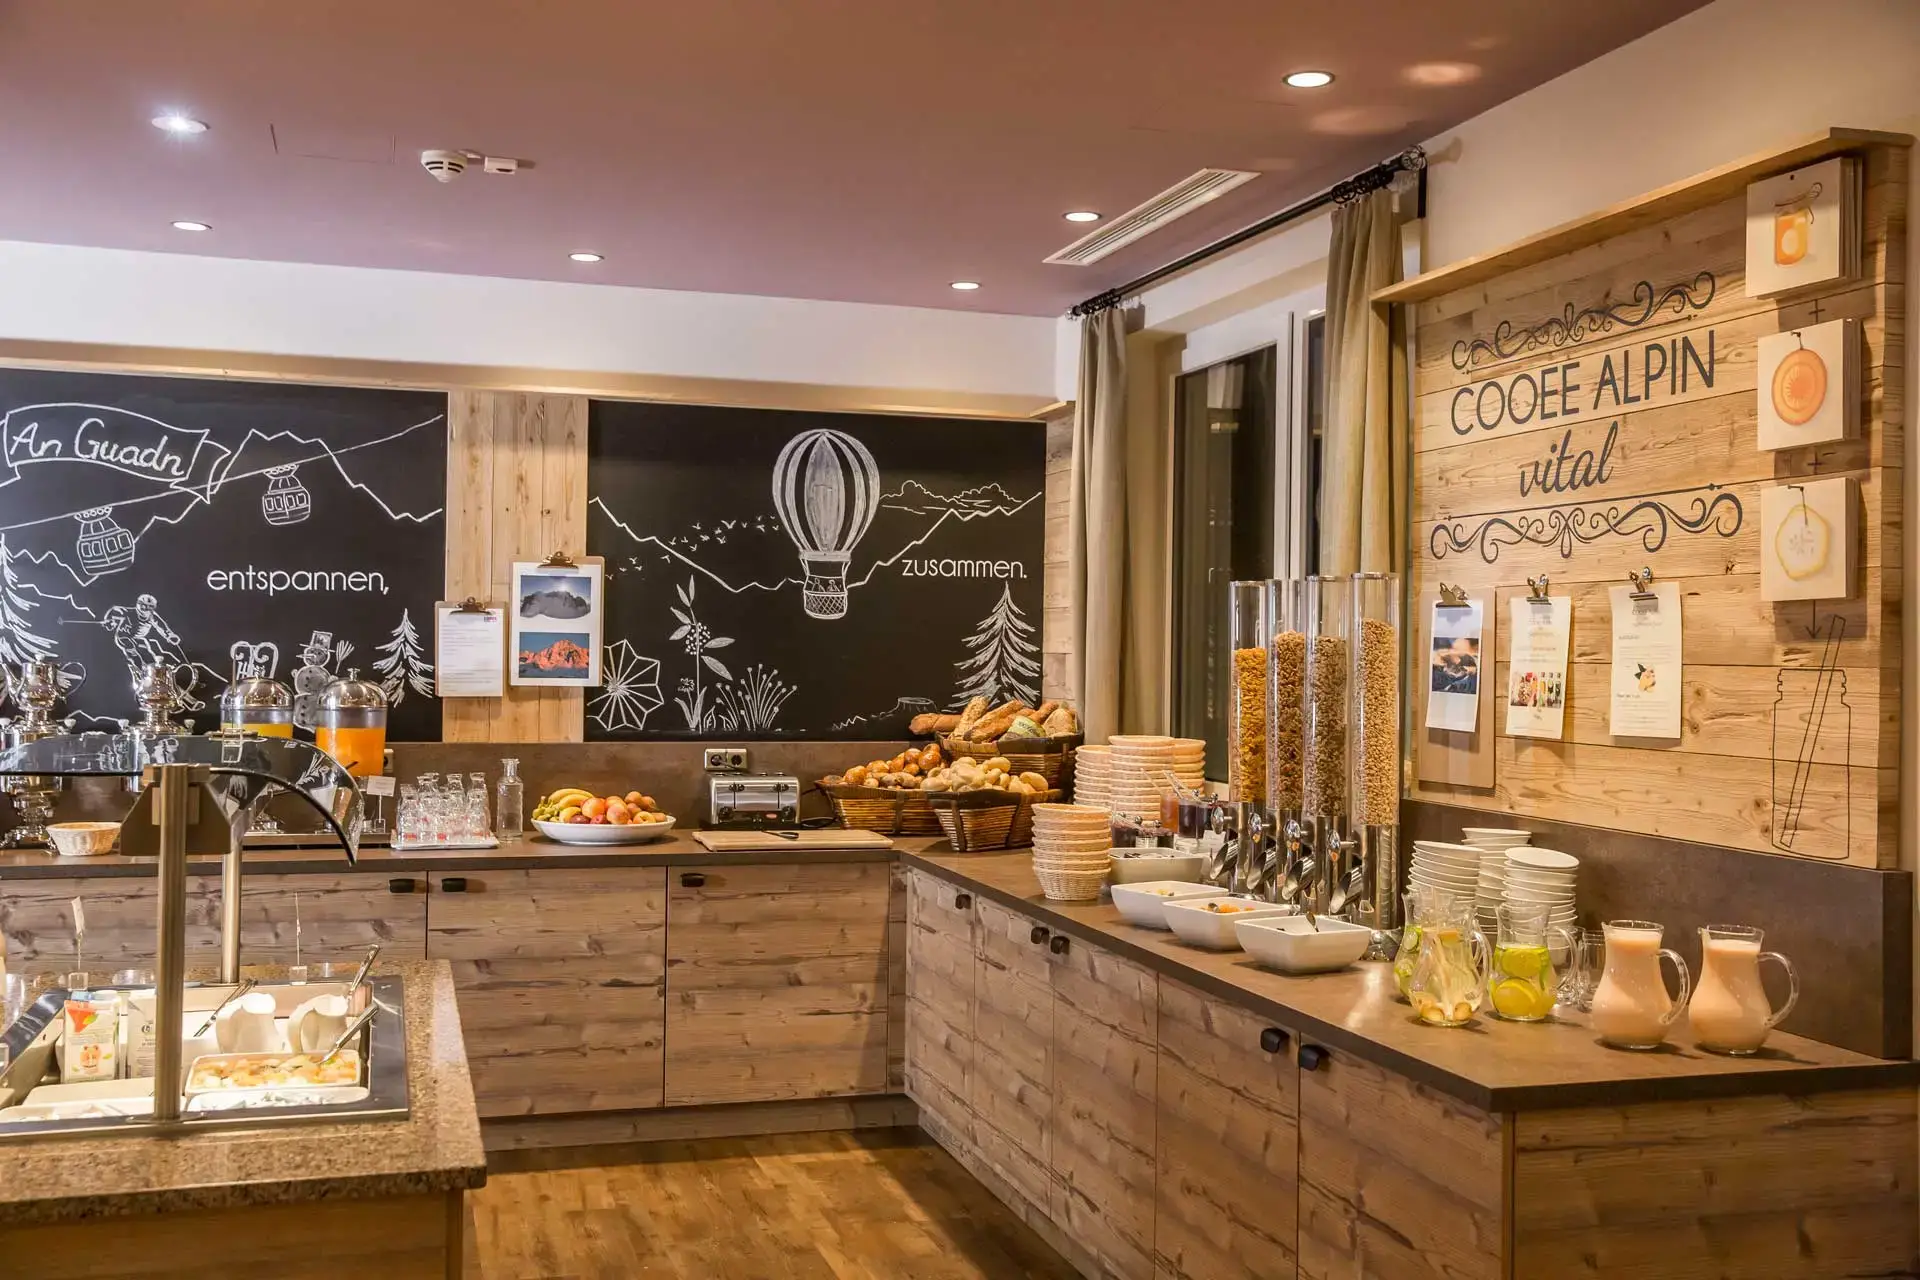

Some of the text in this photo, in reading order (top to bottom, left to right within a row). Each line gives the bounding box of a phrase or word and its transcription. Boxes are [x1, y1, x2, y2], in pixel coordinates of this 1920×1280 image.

[1451, 329, 1714, 435] COOEE ALPIN
[10, 418, 184, 476] An Guadn
[1518, 420, 1618, 498] vital
[207, 565, 390, 596] entspannen,
[902, 559, 1028, 579] zusammen.
